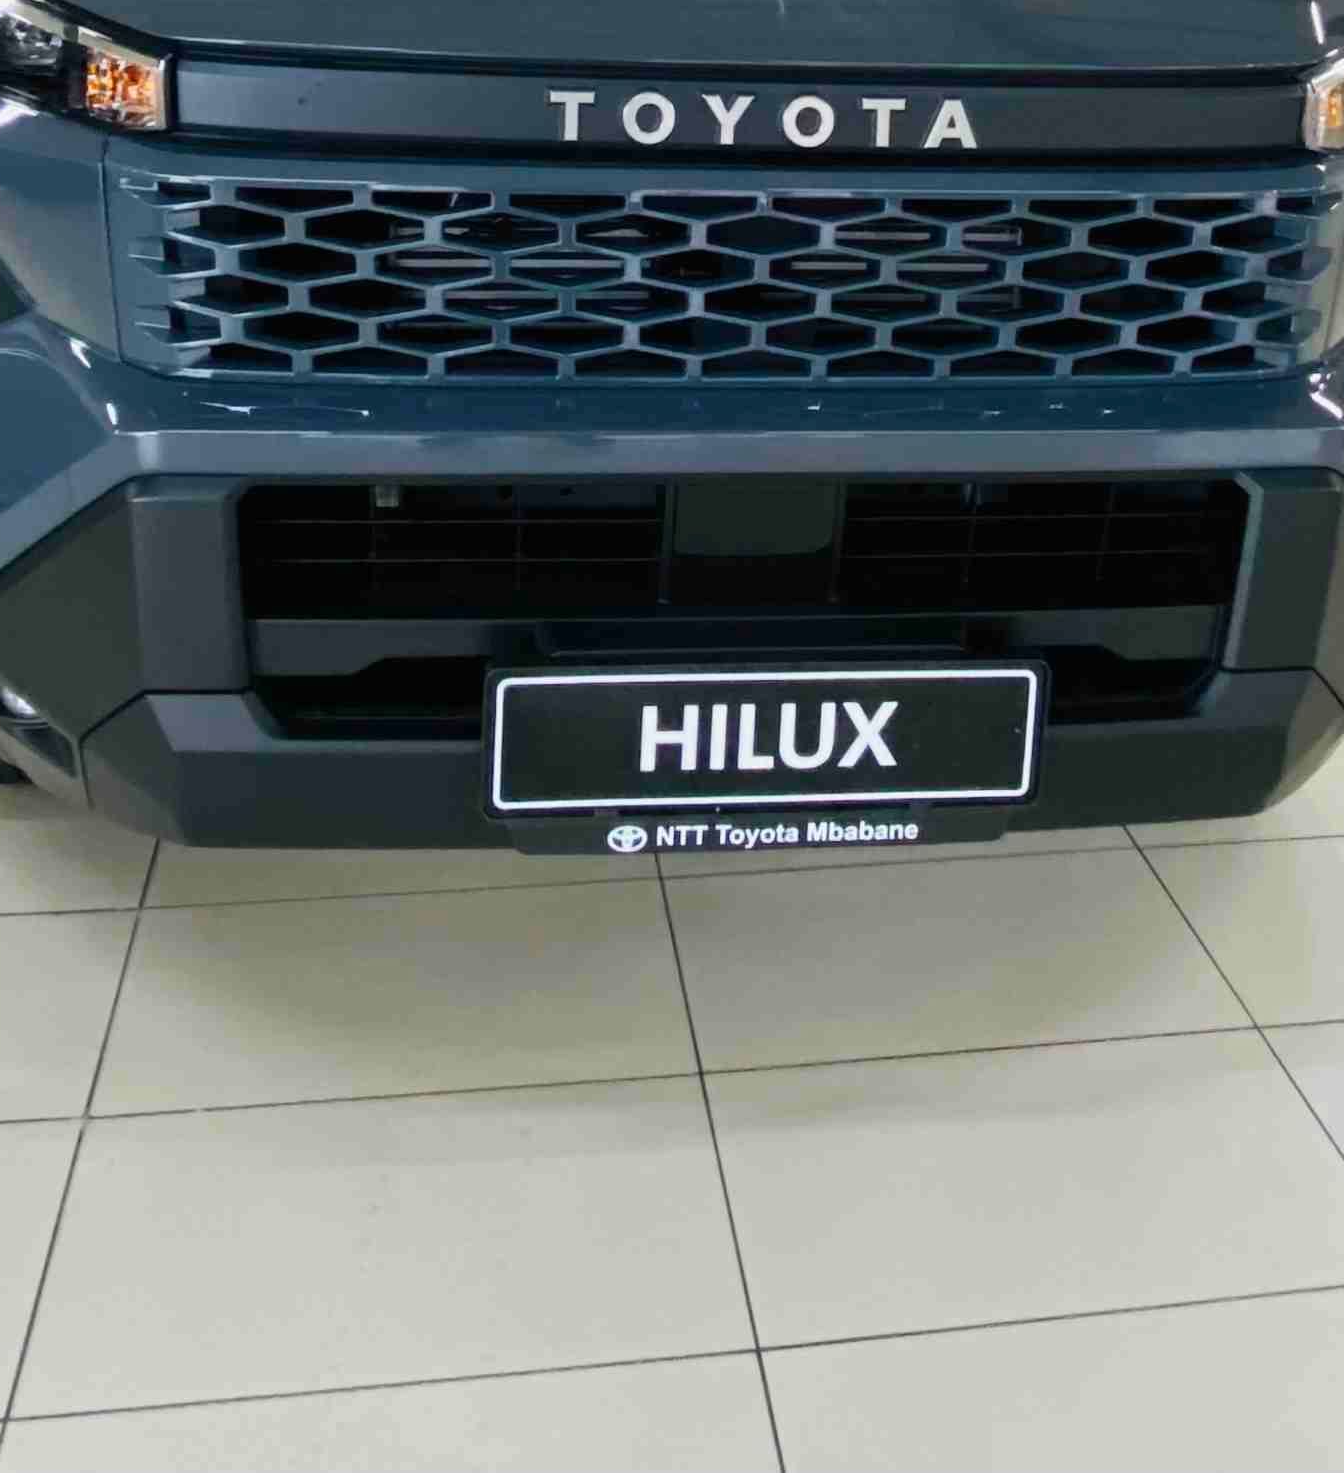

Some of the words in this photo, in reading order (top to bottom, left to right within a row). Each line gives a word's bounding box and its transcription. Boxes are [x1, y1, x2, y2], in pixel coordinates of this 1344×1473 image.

[549, 90, 978, 149] TOYOTA
[639, 700, 899, 773] HILUX
[656, 824, 709, 847] NTT
[714, 822, 800, 850] Toyota
[806, 819, 919, 843] Mbabane
